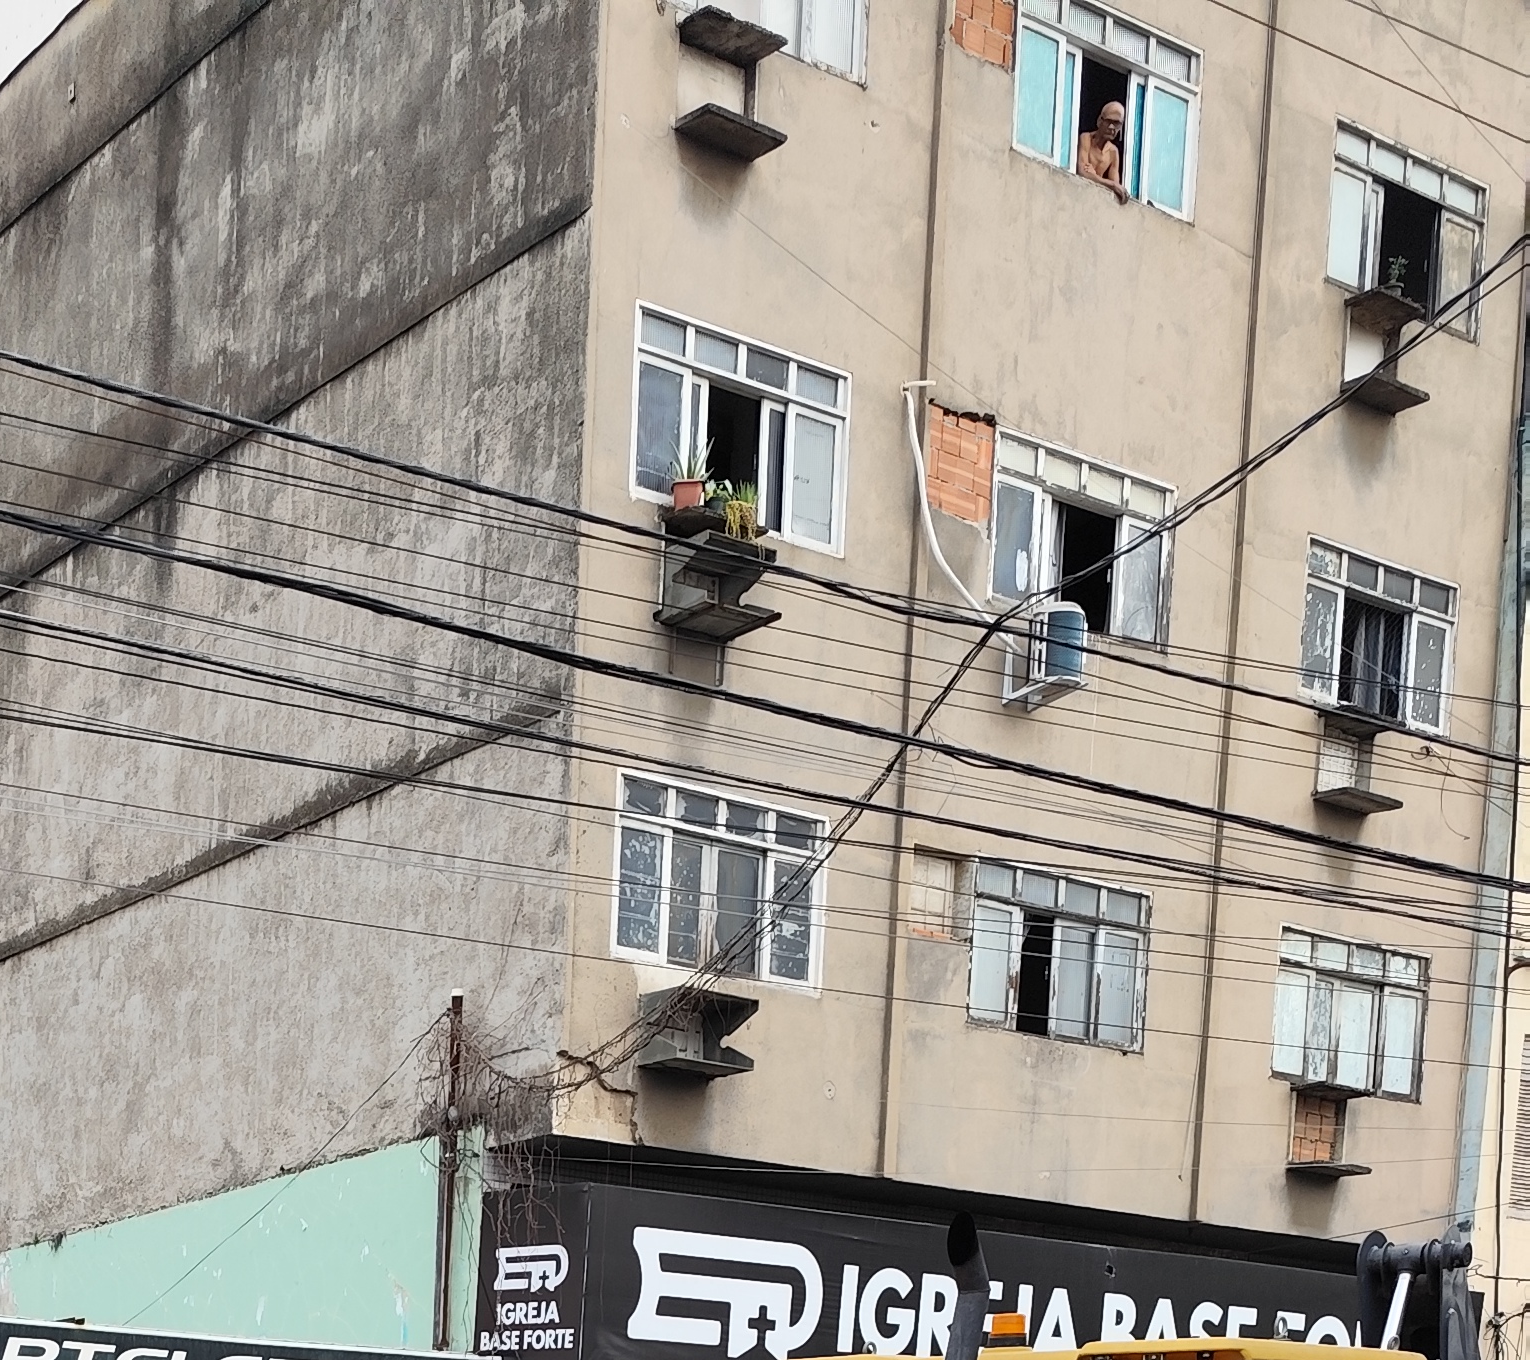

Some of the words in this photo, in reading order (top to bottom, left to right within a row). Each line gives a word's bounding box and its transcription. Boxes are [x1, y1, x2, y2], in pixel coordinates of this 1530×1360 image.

[496, 1301, 560, 1326] IGREJA
[480, 1331, 521, 1351] BASE
[523, 1329, 574, 1349] FORTE
